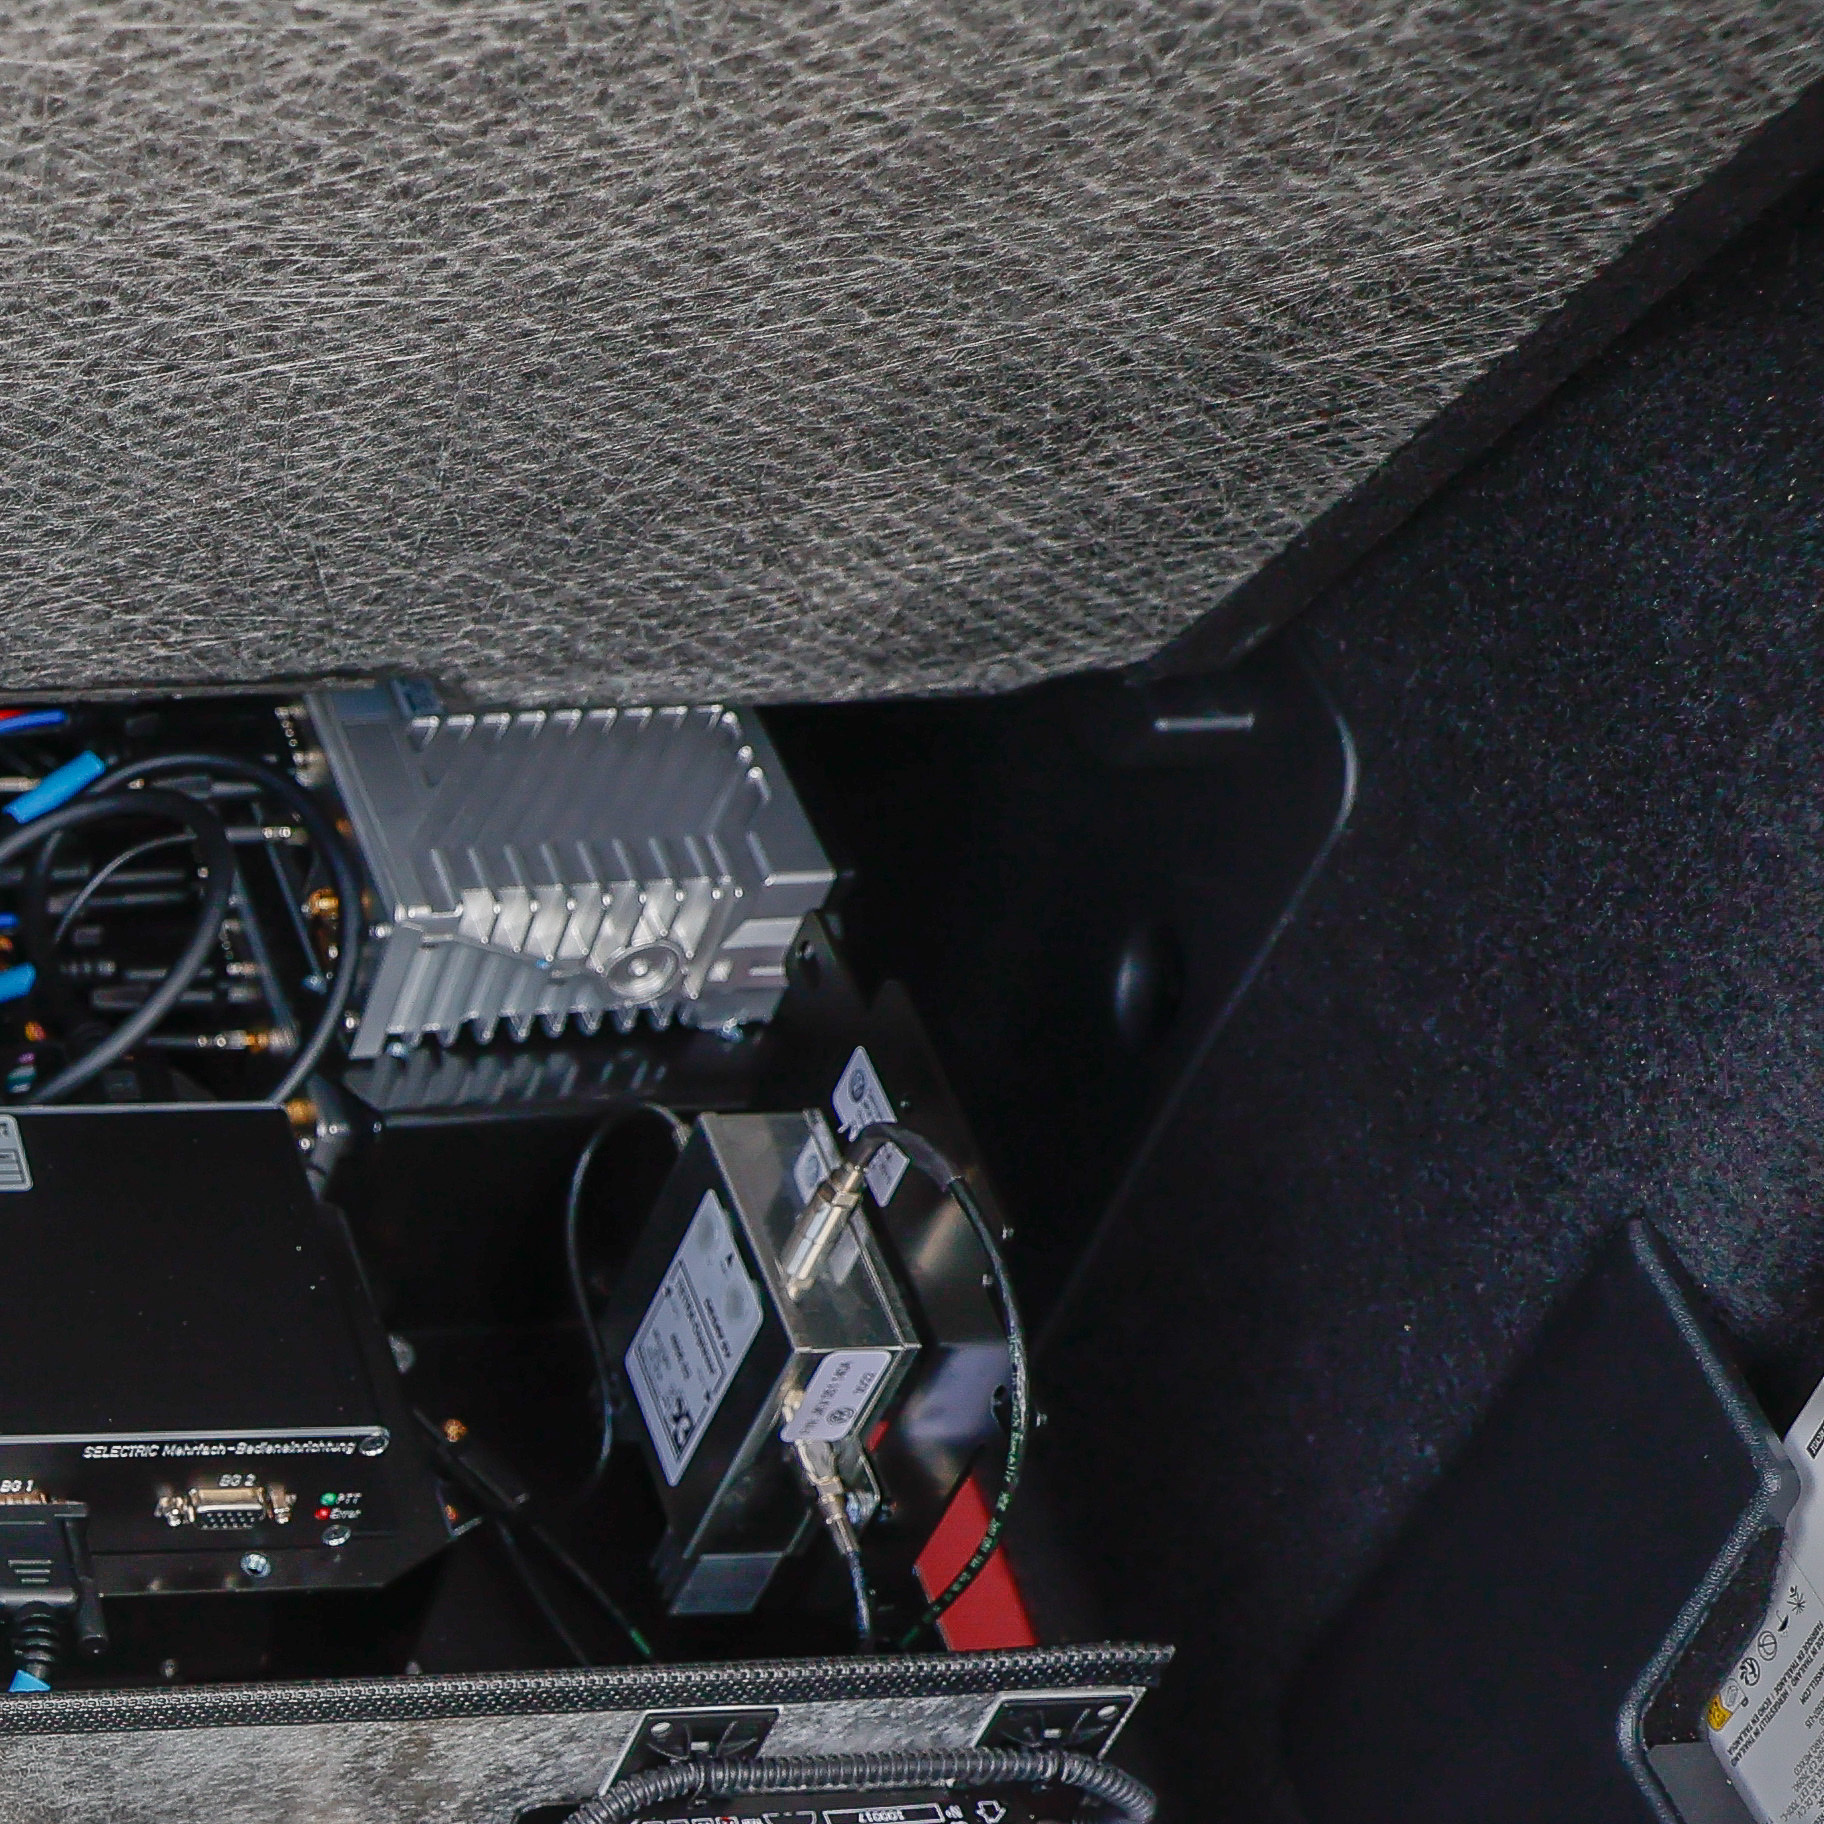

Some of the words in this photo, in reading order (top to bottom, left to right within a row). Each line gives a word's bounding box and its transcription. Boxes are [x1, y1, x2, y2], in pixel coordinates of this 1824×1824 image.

[83, 1444, 159, 1458] SELECTRIC
[0, 1480, 23, 1493] BG
[25, 1480, 34, 1492] 1
